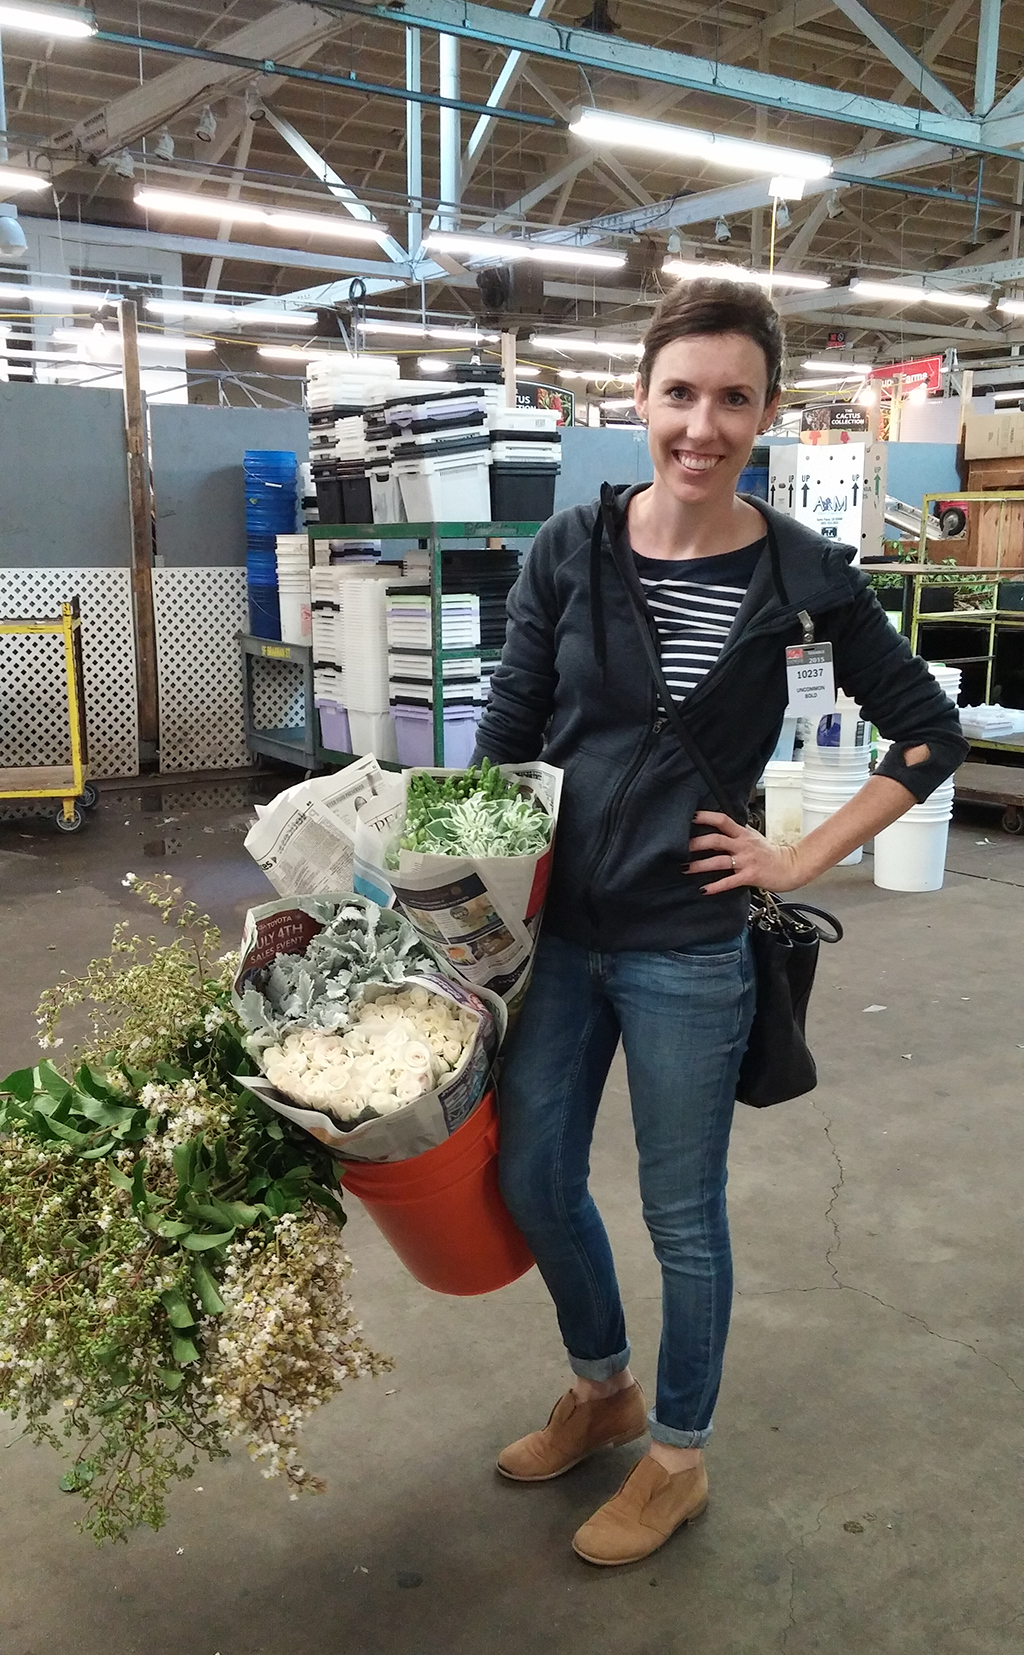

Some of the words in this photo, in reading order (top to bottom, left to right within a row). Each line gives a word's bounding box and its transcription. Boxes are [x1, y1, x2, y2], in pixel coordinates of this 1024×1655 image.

[801, 474, 810, 482] UP
[852, 474, 860, 482] UP
[797, 668, 824, 679] 10237
[796, 685, 825, 693] UNCOMMON
[267, 915, 293, 929] TOYOTA
[256, 932, 275, 950] ULY
[277, 923, 303, 939] 4TH
[250, 946, 275, 964] SALES
[276, 935, 304, 951] EVENT
